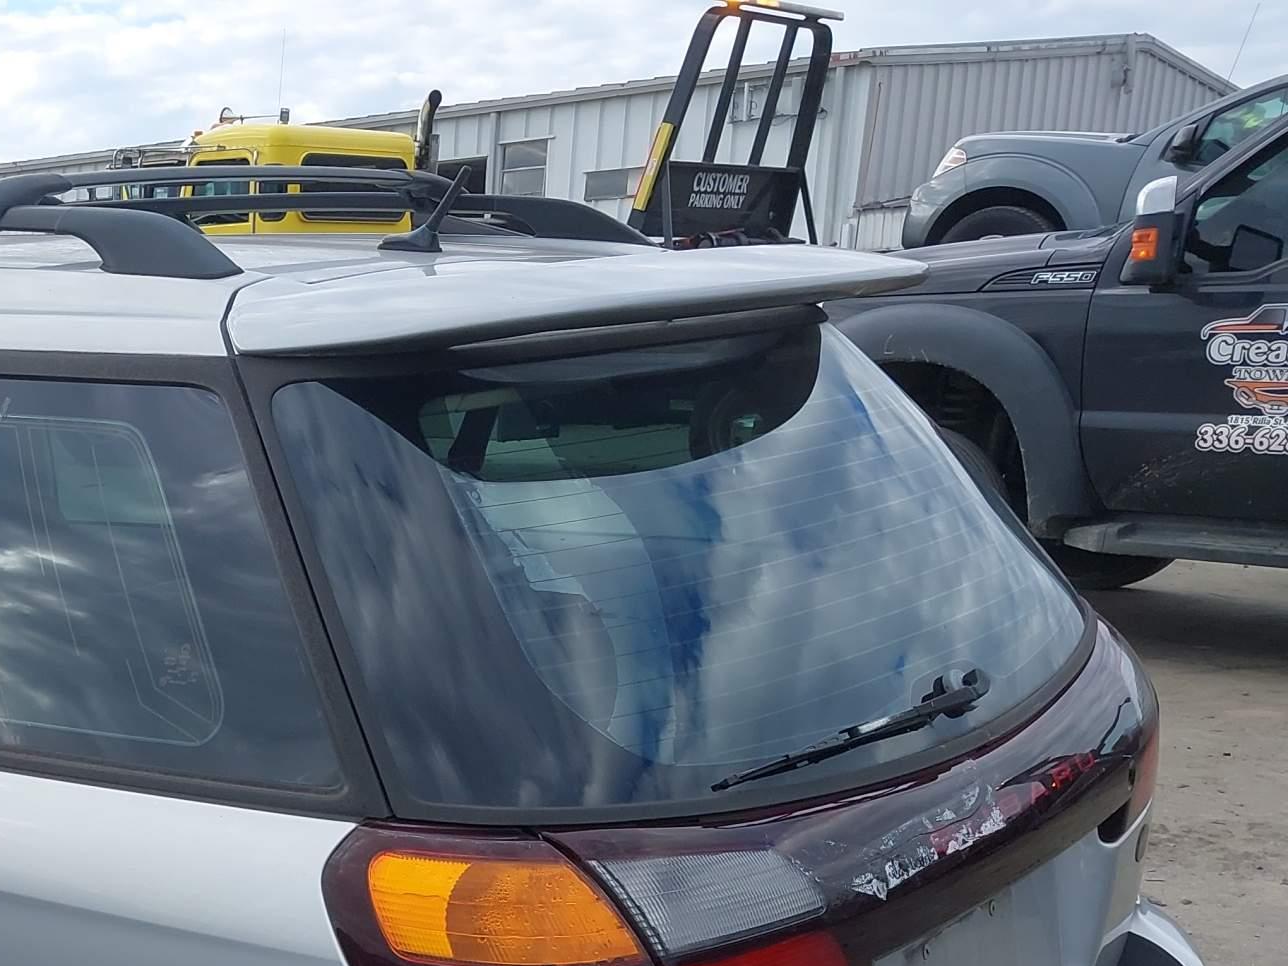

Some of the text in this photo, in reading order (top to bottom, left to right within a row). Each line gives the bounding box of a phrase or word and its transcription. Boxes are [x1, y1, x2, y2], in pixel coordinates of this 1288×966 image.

[693, 172, 750, 193] CUSTOMER
[688, 193, 746, 209] PARKING ONLY
[1195, 423, 1288, 454] 336-62
